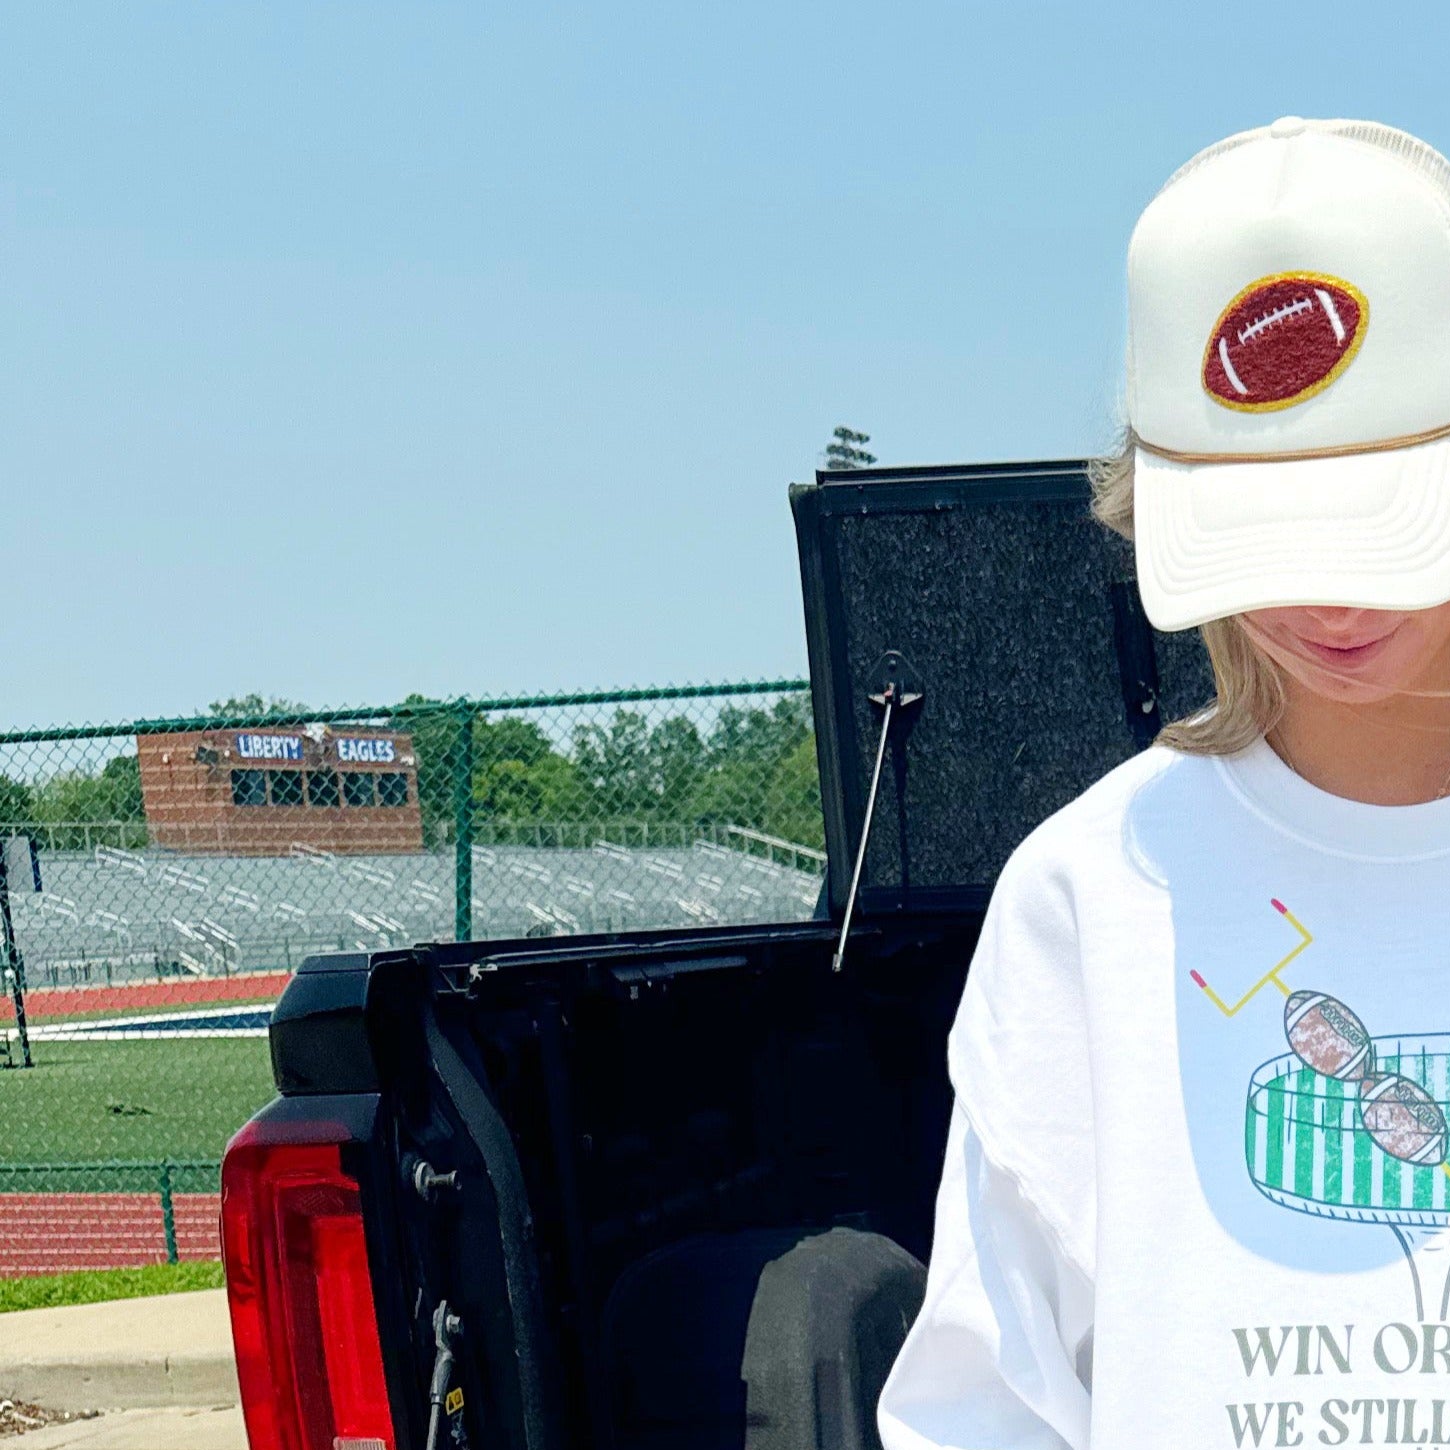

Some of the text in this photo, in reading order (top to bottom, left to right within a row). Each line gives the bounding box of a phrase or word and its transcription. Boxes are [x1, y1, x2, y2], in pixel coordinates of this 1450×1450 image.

[238, 734, 395, 763] LIBERTY EAGLES
[1231, 1324, 1355, 1377] WIN
[1225, 1401, 1304, 1449] WE
